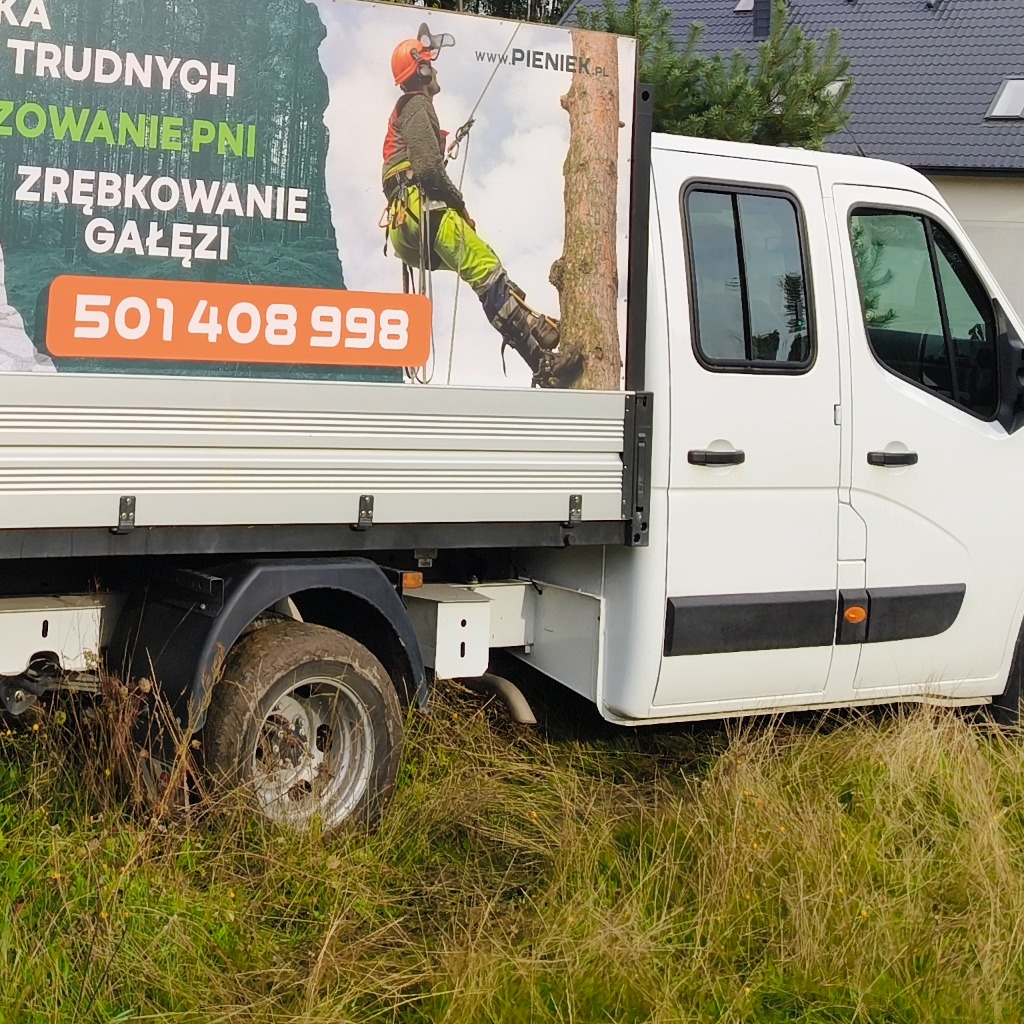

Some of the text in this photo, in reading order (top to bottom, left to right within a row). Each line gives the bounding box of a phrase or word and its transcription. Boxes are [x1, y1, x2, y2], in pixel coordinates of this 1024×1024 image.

[6, 38, 236, 98] TRUDNYCH
[191, 120, 256, 158] PNI
[15, 164, 309, 223] ZRĘBKOWANIE
[84, 217, 230, 269] GAŁĘZI
[73, 293, 409, 350] 501 408 998
